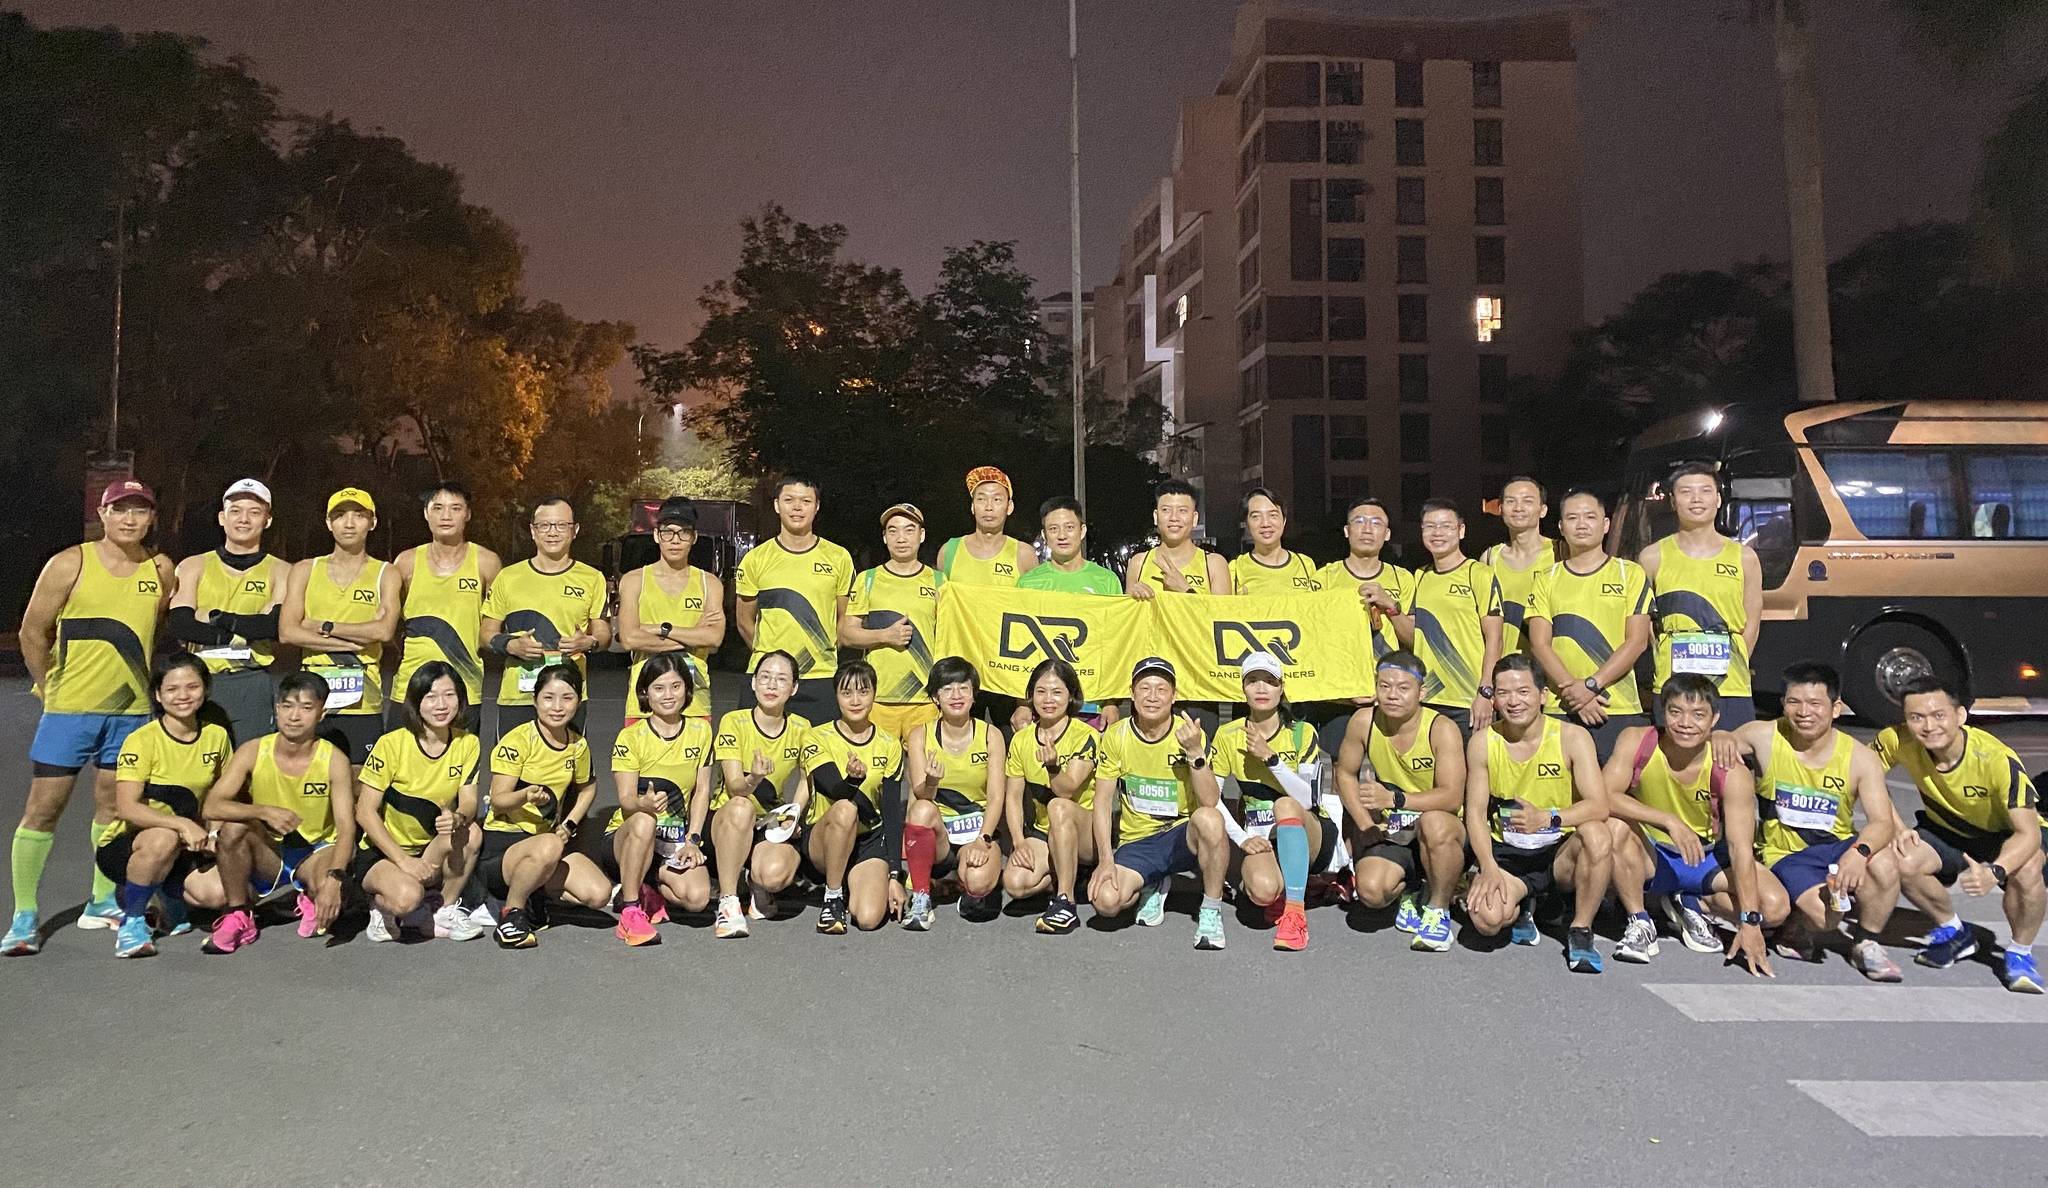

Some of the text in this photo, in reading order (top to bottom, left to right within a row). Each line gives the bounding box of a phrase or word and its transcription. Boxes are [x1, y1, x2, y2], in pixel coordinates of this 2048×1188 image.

[1688, 643, 1723, 656] 90813
[988, 660, 1020, 672] DANG
[1208, 670, 1241, 679] DANG
[325, 677, 356, 690] 0618
[1138, 784, 1170, 798] 80561
[1791, 793, 1830, 811] 90172
[1256, 810, 1275, 822] 902
[953, 815, 984, 832] 91313
